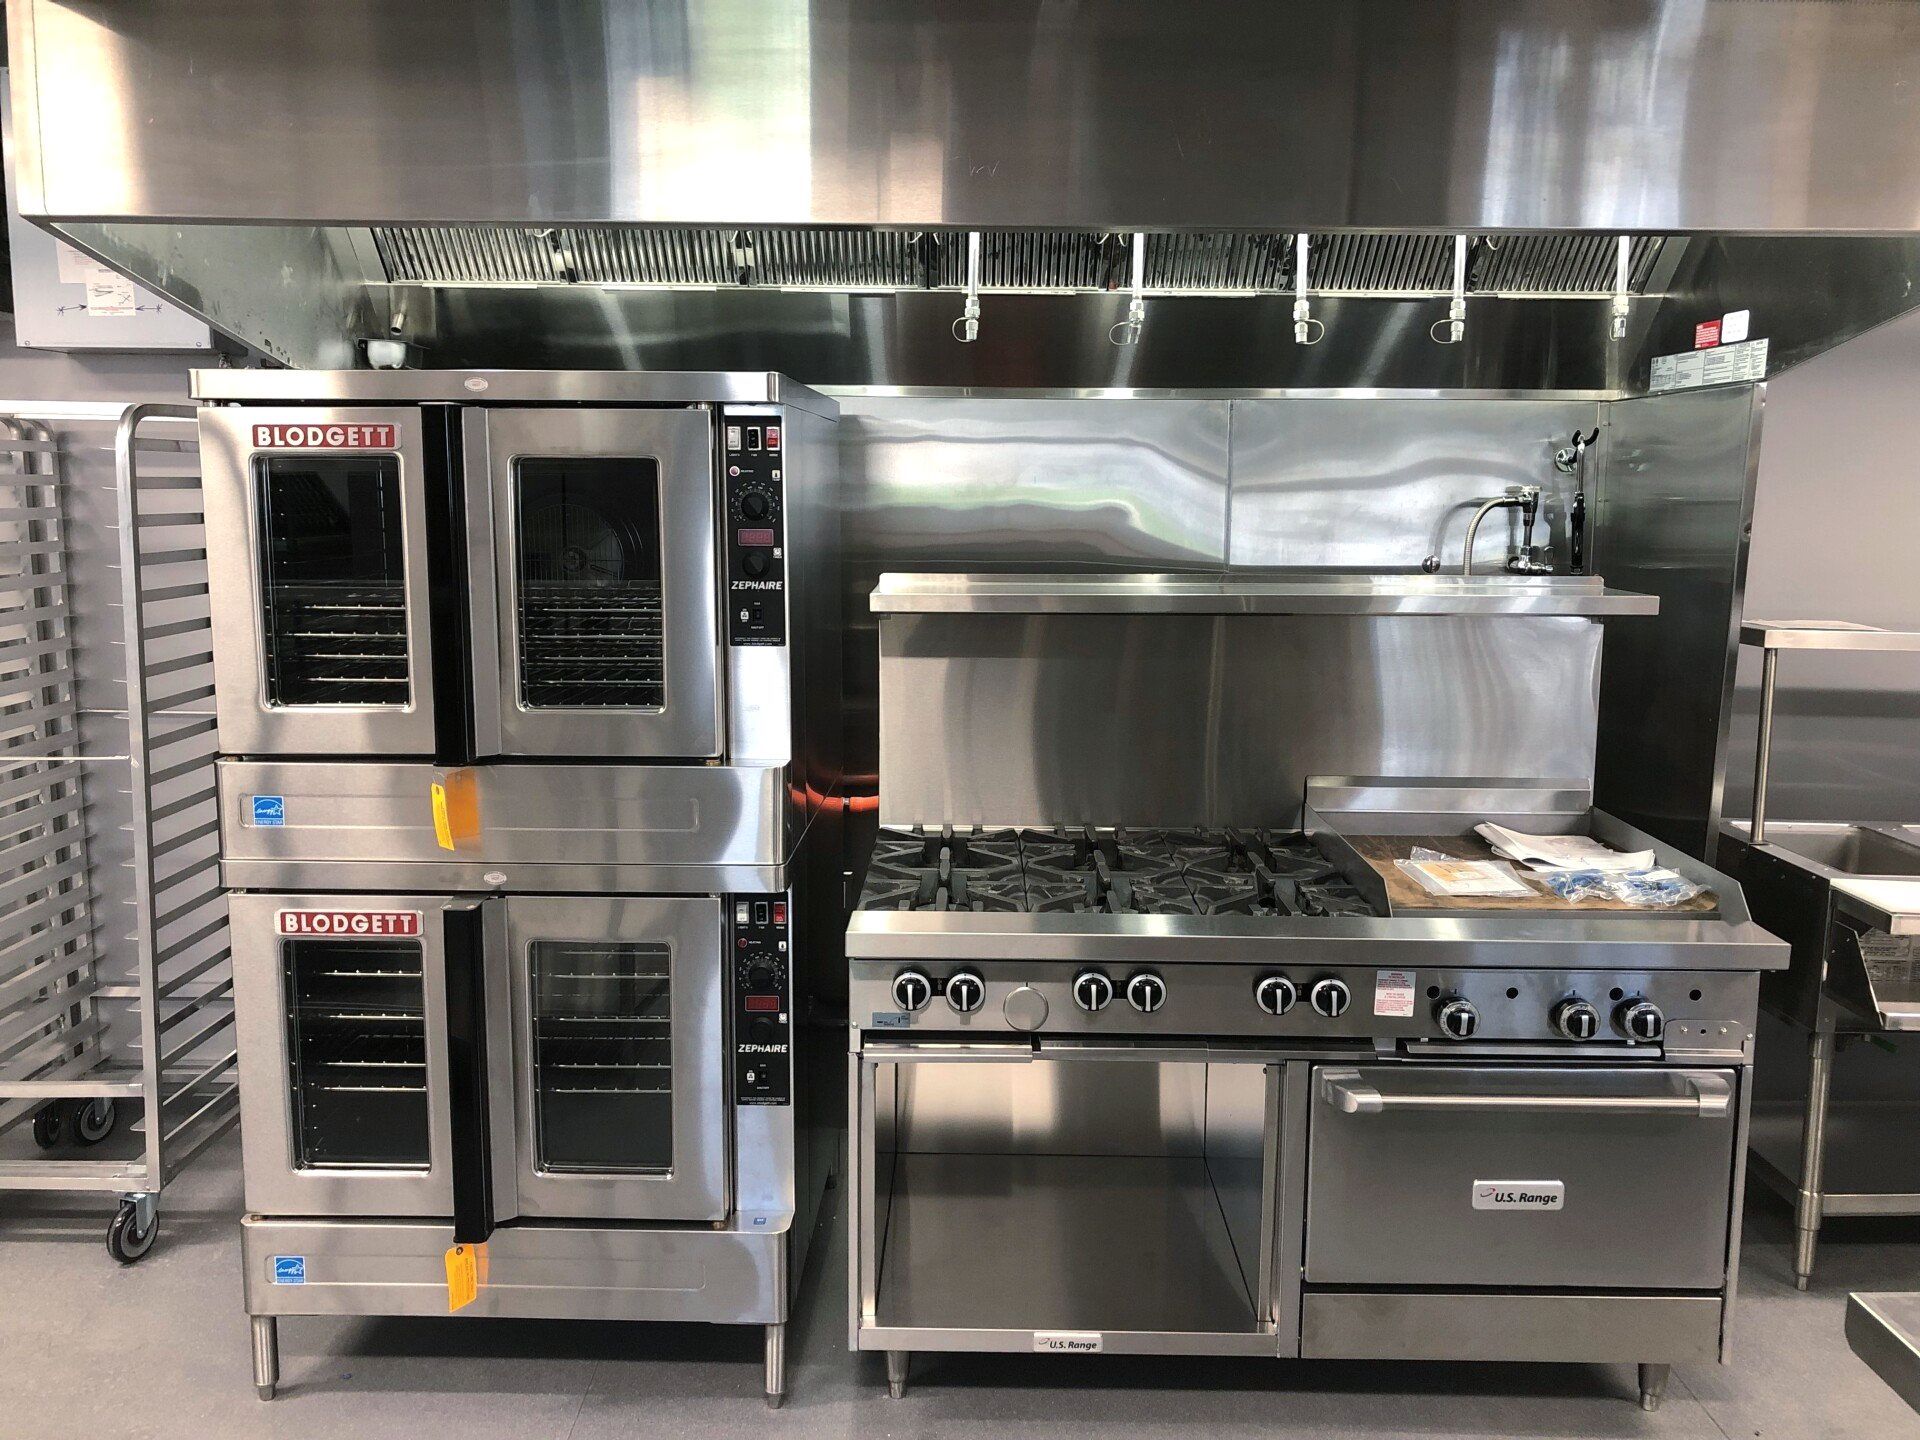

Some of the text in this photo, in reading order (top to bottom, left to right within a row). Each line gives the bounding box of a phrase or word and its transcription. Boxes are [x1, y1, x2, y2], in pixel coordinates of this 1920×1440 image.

[257, 426, 391, 447] BLODGETT
[731, 581, 783, 590] ZEPHAIRE
[284, 913, 413, 933] BLODGETT
[738, 1044, 788, 1053] ZEPHAIRE
[1494, 1192, 1558, 1206] U.S. Range
[1049, 1340, 1098, 1351] U.S. Range
